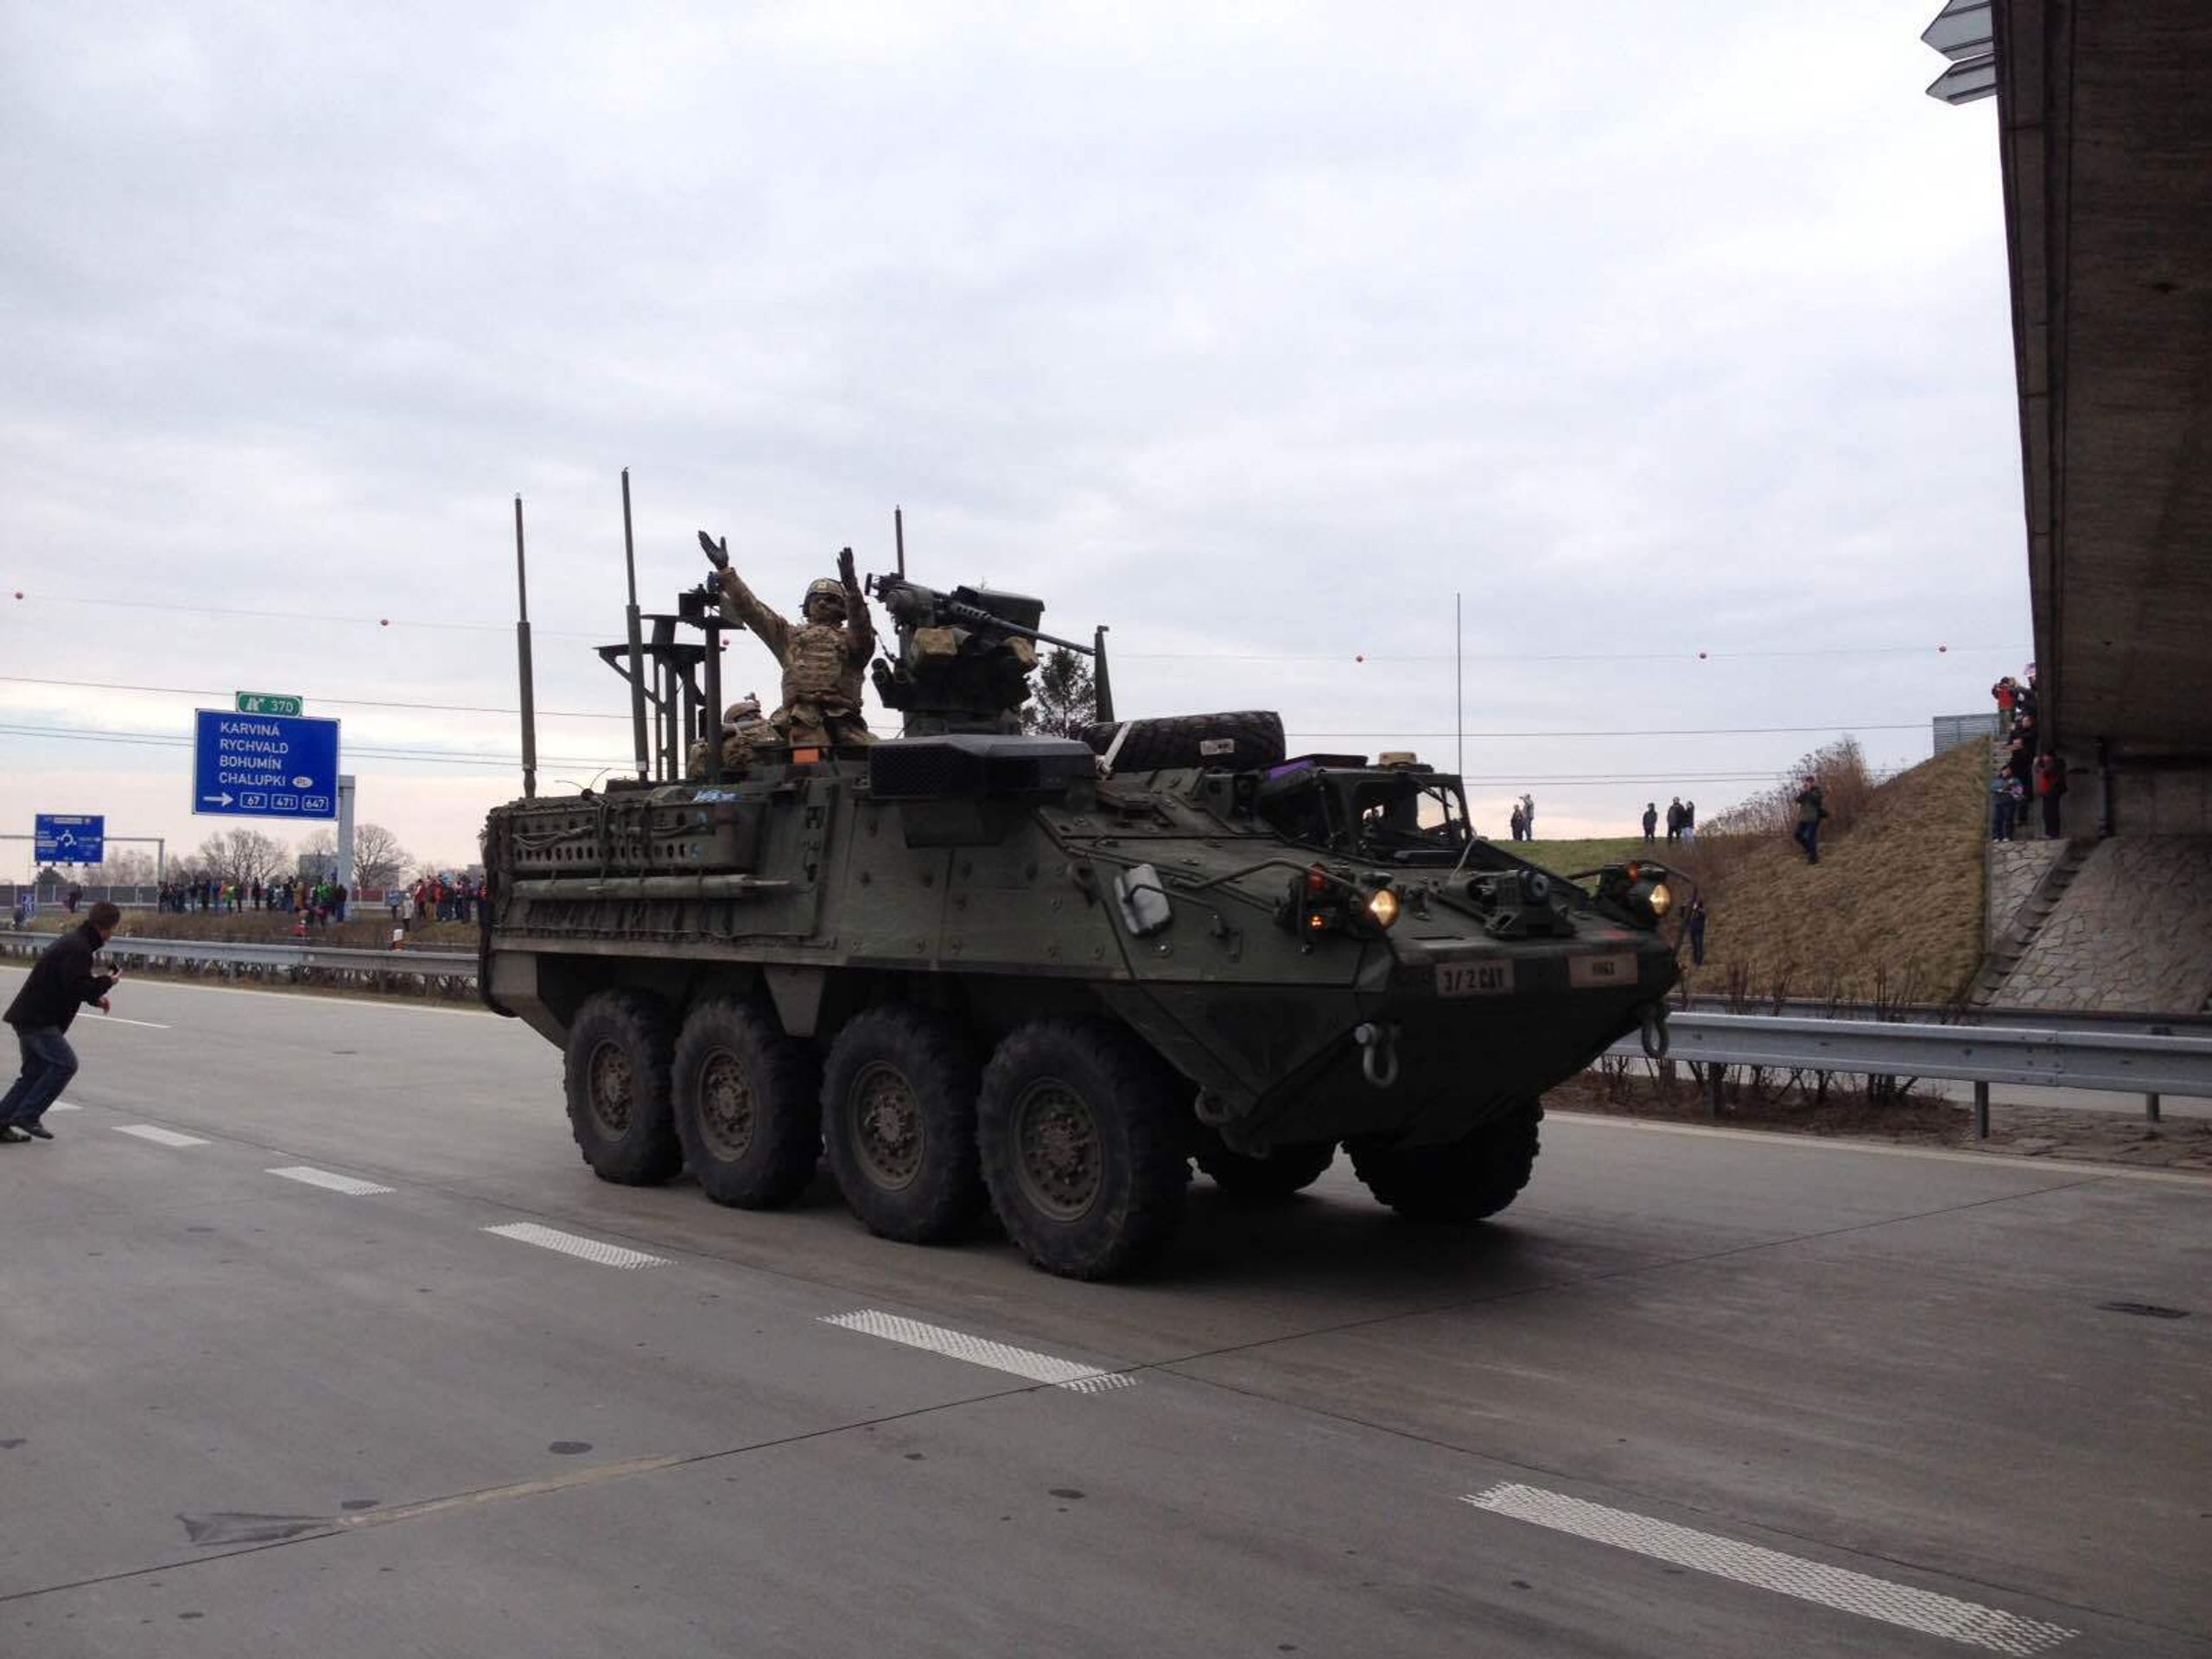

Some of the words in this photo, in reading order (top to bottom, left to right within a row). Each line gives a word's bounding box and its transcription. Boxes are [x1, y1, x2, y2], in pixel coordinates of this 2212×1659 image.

[271, 700, 293, 712] 370
[220, 721, 280, 736] KARVINÁ
[220, 739, 289, 753] RYCHVALD
[219, 755, 282, 770] BOHUMÍN
[219, 772, 286, 786] CHALUPKI
[247, 796, 259, 805] 67
[276, 798, 294, 806] 471
[305, 798, 324, 808] 647
